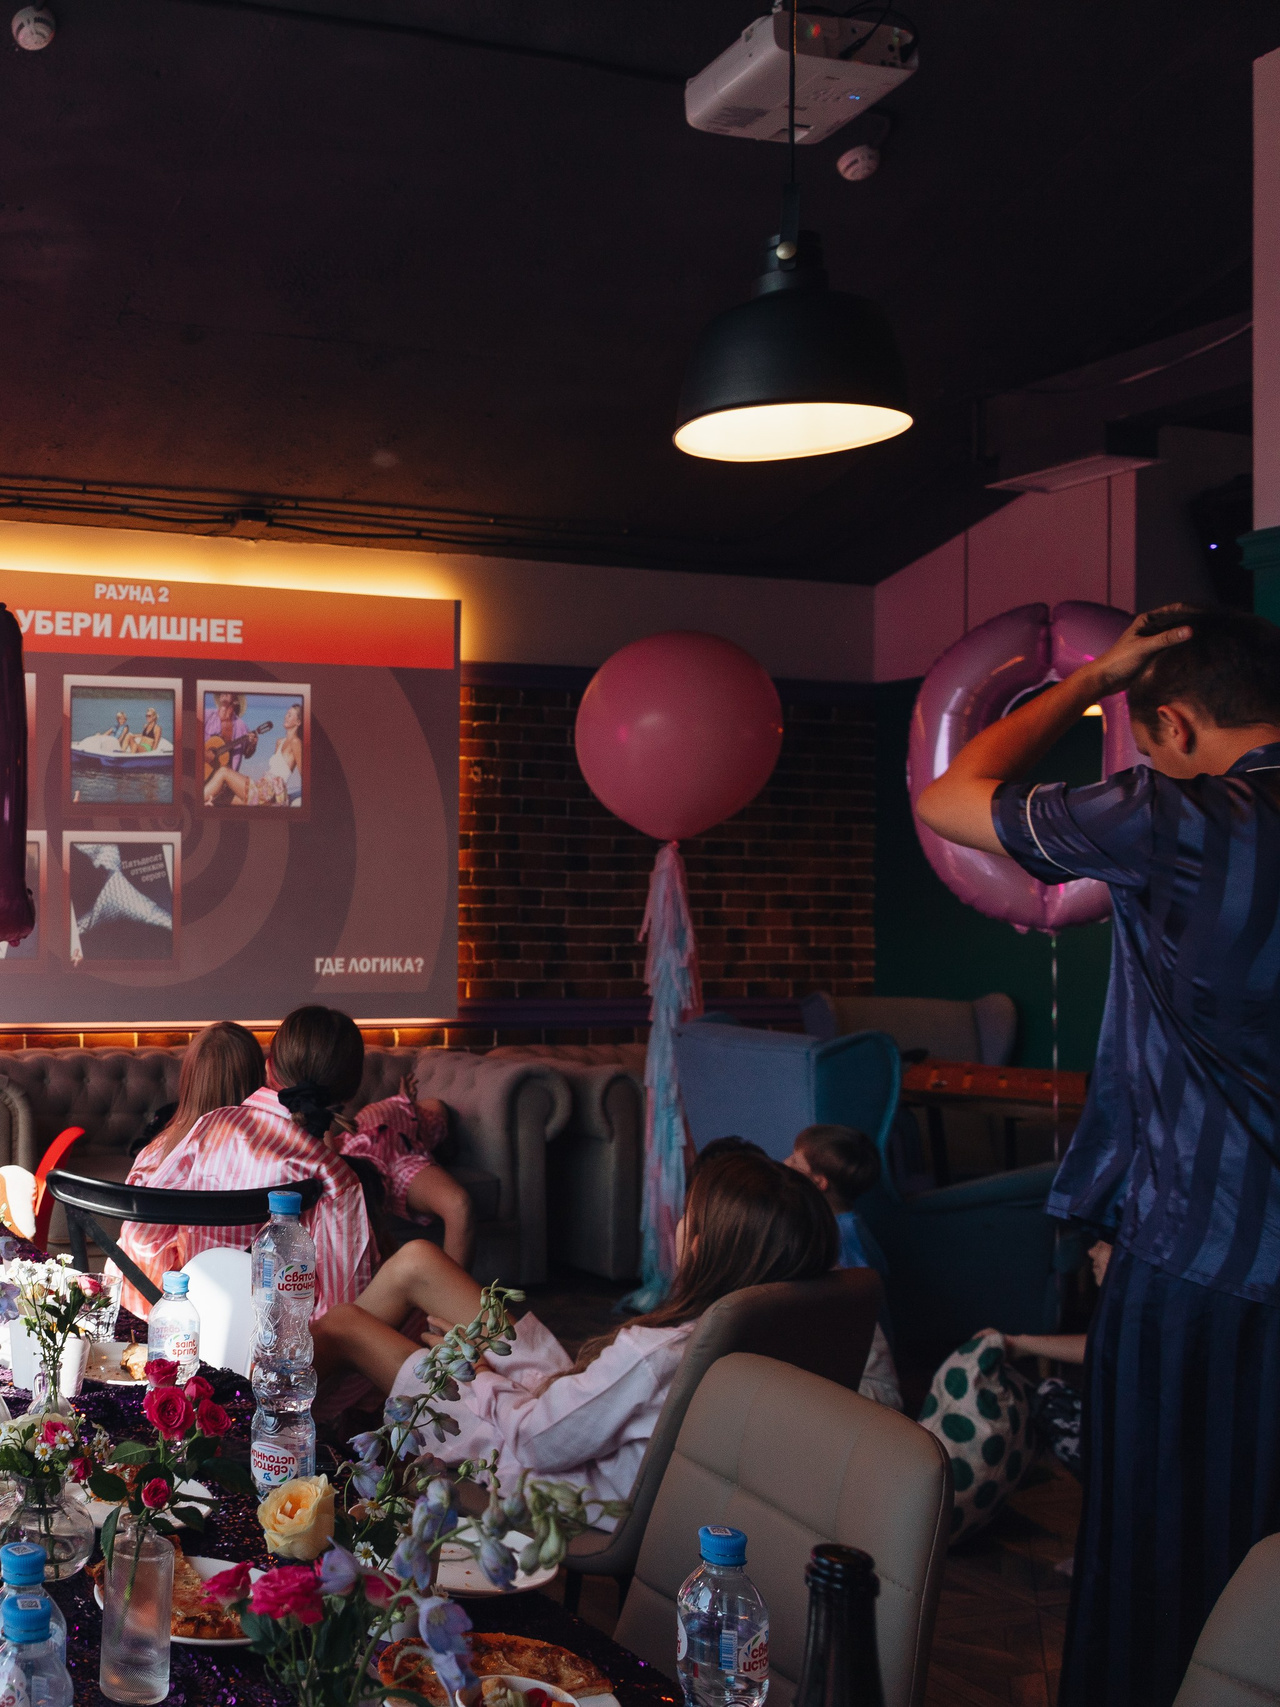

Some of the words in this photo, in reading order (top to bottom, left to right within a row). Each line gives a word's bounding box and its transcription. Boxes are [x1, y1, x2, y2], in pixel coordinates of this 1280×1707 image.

[95, 583, 155, 604] РАУНД
[158, 587, 169, 602] 2
[16, 609, 112, 638] УБЕРИ
[119, 614, 243, 644] ЛИШНЕЕ
[315, 957, 345, 976] ГДЕ
[348, 957, 424, 973] ЛОГИКА?
[172, 1346, 198, 1357] spring
[175, 1339, 196, 1348] saint
